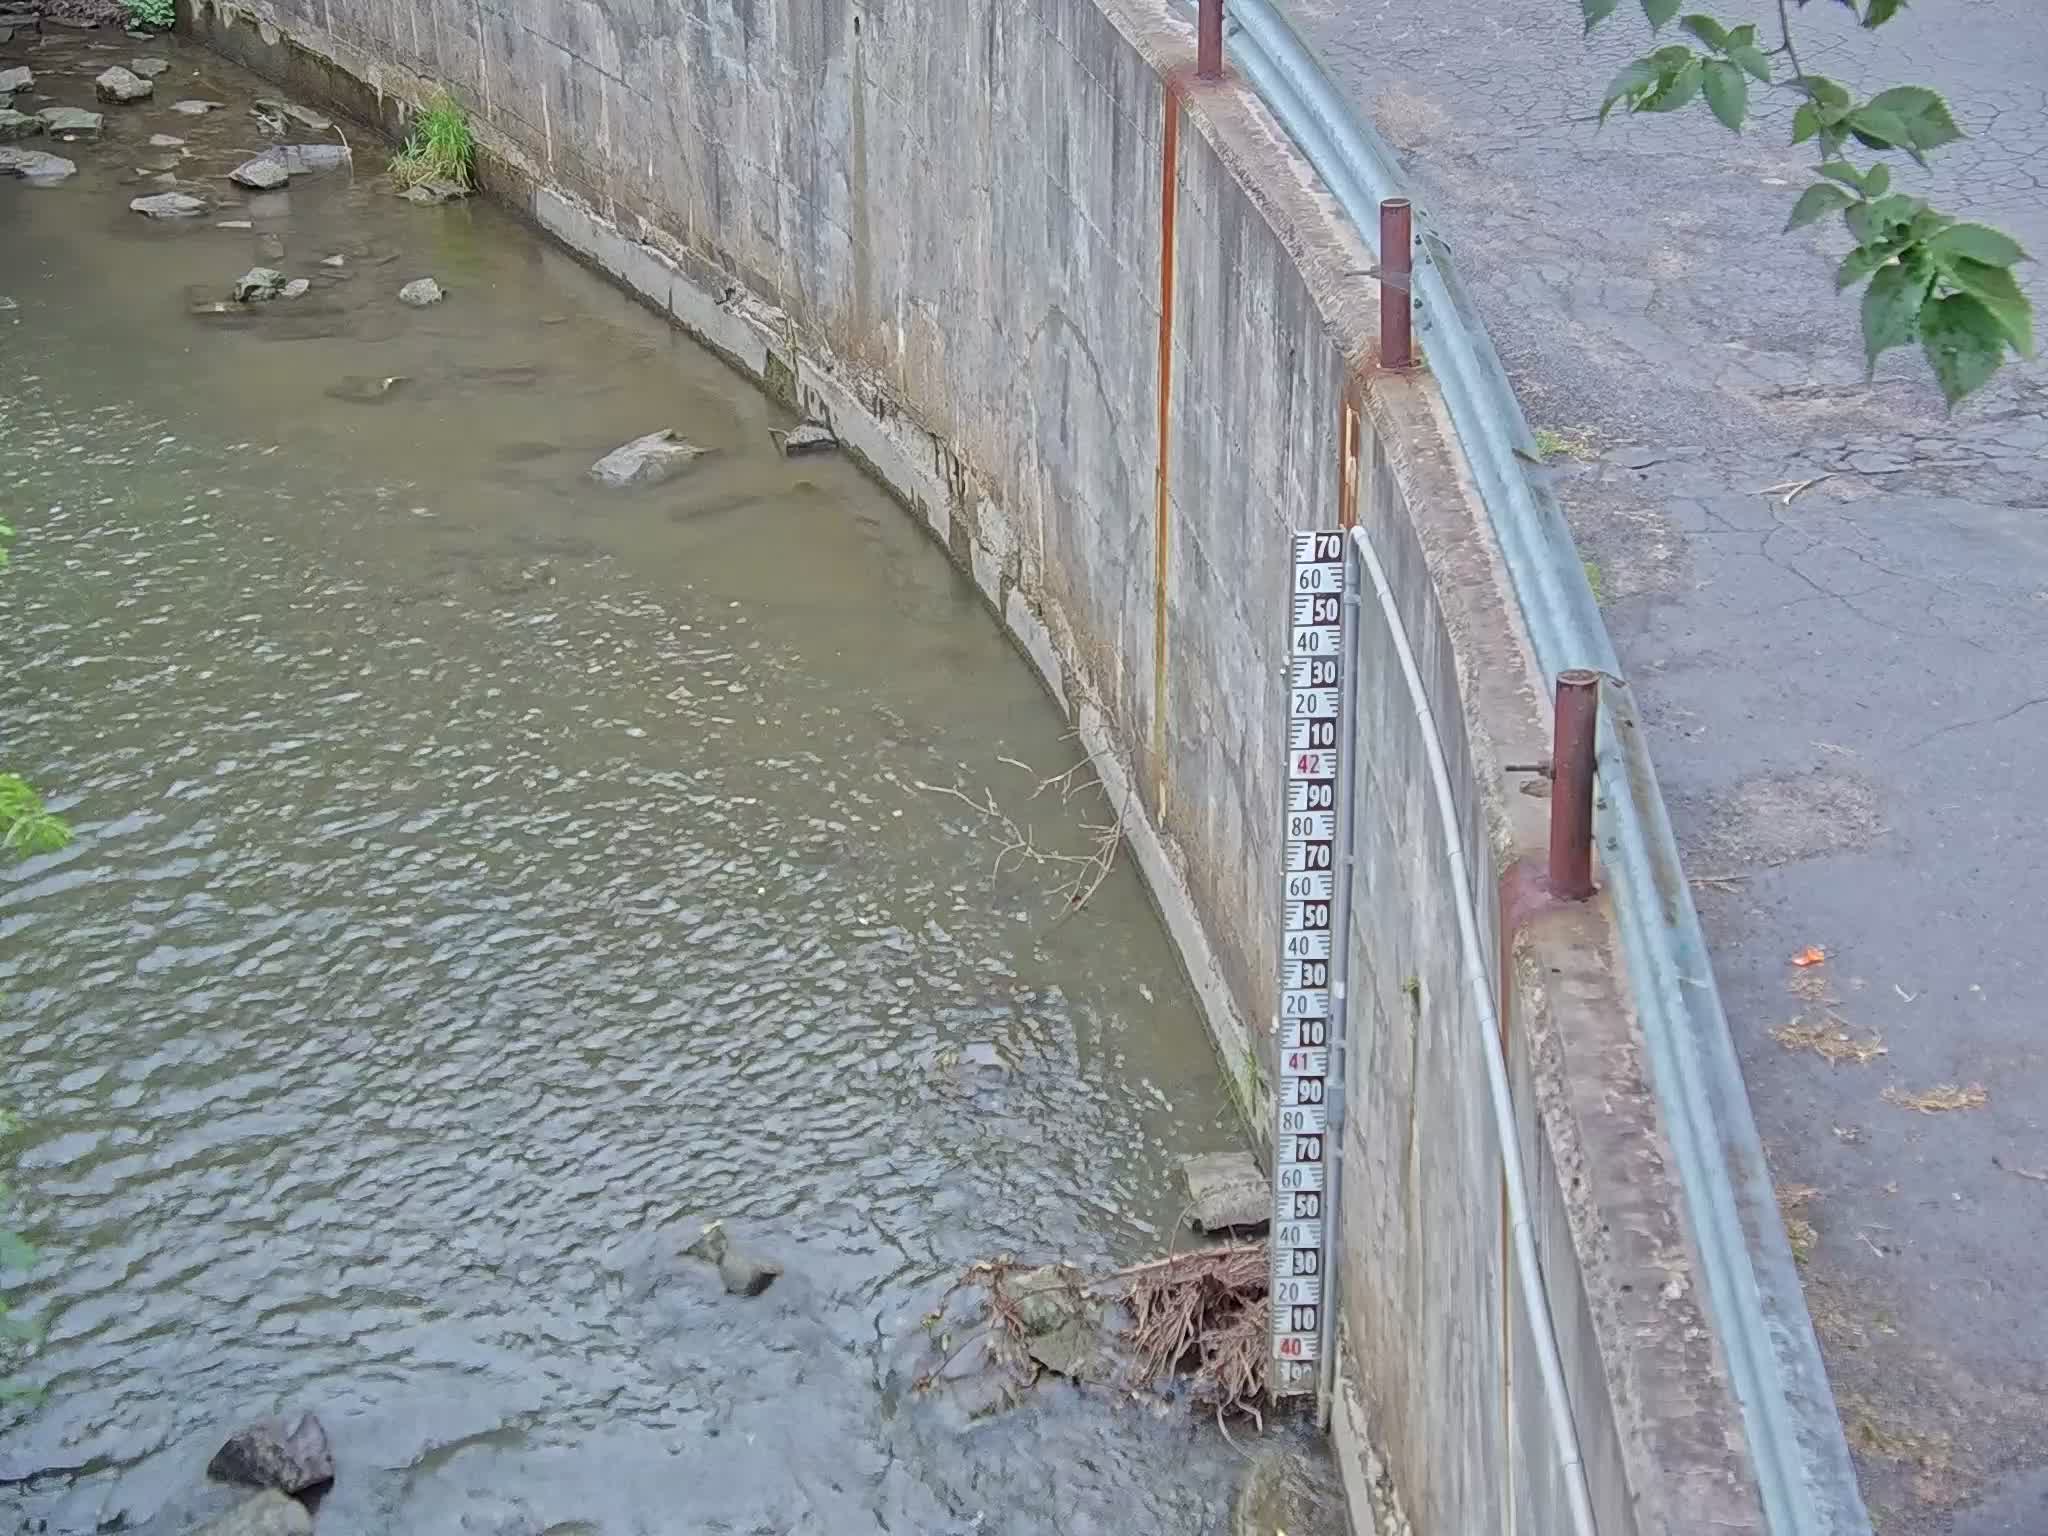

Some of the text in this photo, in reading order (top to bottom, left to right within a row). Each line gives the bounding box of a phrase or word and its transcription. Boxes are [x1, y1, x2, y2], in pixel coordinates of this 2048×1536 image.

[1316, 535, 1341, 559] 70
[1300, 569, 1320, 590] 60
[1314, 597, 1338, 622] 50
[1297, 632, 1319, 652] 40
[1312, 661, 1336, 684] 30
[1296, 694, 1317, 713] 20
[1311, 722, 1334, 745] 10
[1297, 754, 1320, 774] 42
[1308, 785, 1332, 808] 90
[1291, 816, 1313, 837] 80
[1306, 844, 1330, 868] 70
[1290, 876, 1311, 897] 60
[1304, 904, 1328, 928] 50
[1288, 935, 1309, 956] 40
[1302, 962, 1326, 987] 30
[1286, 994, 1308, 1014] 20
[1301, 1020, 1324, 1045] 10
[1288, 1052, 1308, 1071] 41
[1299, 1079, 1322, 1102] 90
[1282, 1111, 1304, 1130] 80
[1298, 1136, 1320, 1160] 70
[1281, 1168, 1302, 1189] 60
[1295, 1193, 1319, 1217] 50
[1280, 1226, 1300, 1246] 40
[1294, 1250, 1317, 1274] 30
[1279, 1282, 1299, 1301] 20
[1293, 1306, 1316, 1331] 10
[1280, 1338, 1302, 1356] 40
